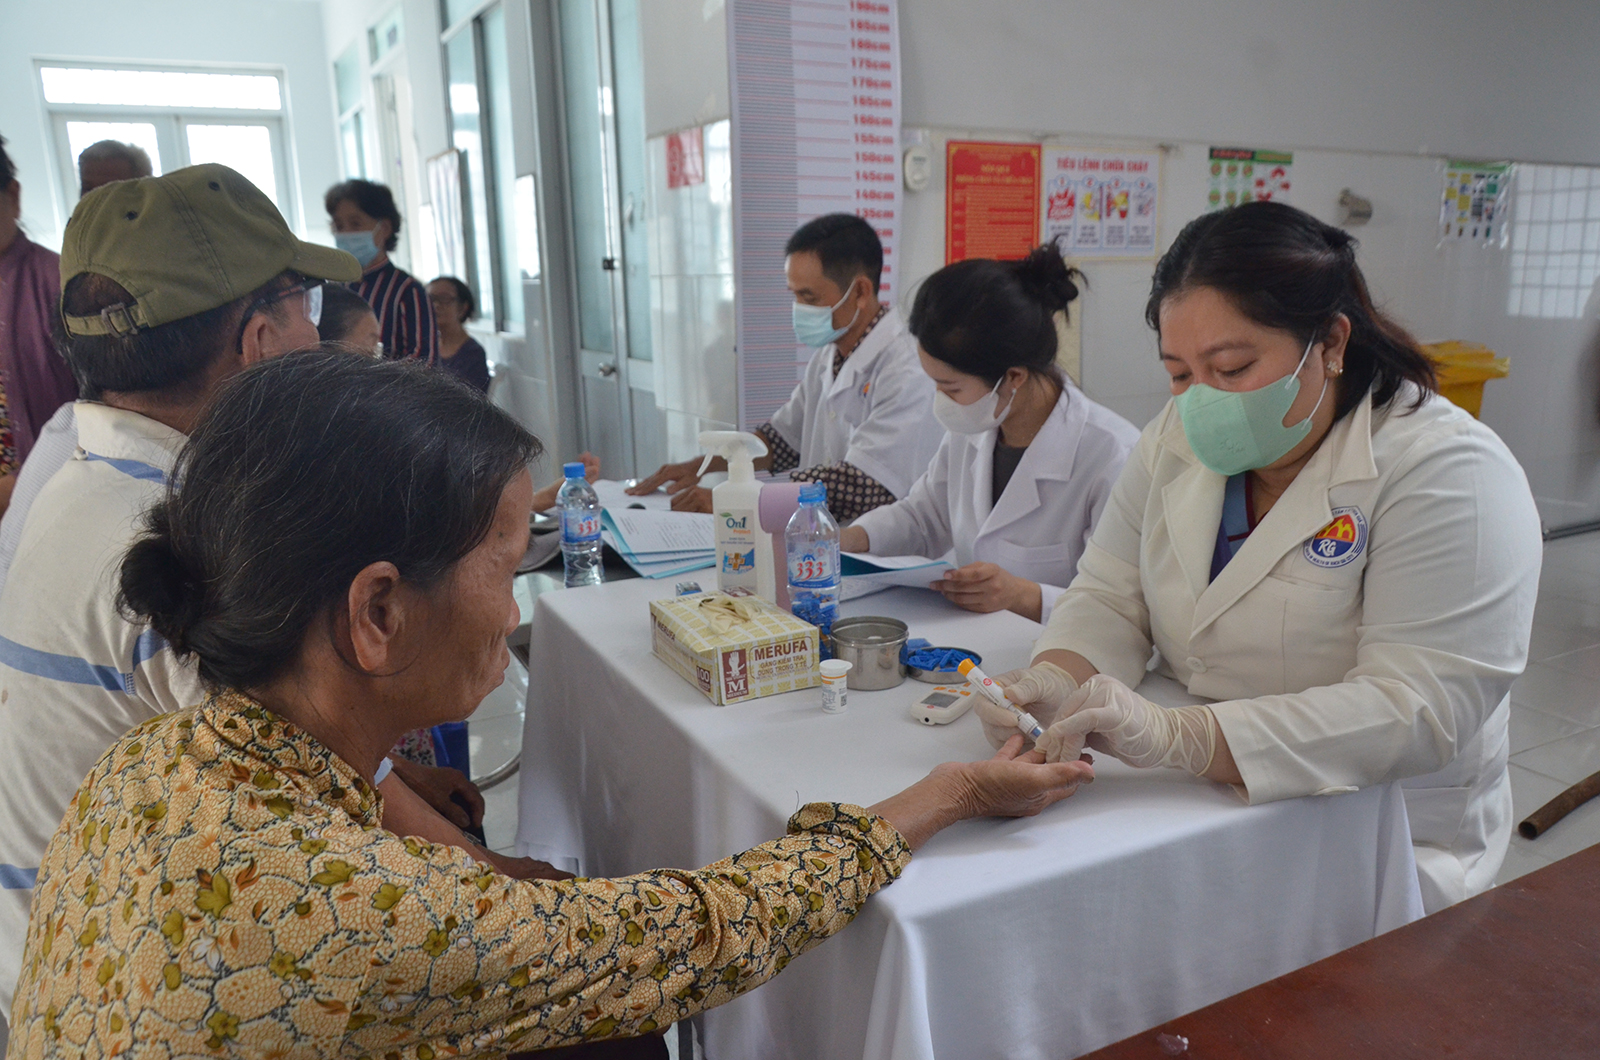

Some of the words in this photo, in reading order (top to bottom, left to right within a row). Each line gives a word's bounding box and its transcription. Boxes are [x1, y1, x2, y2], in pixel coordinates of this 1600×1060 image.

[726, 516, 747, 529] On1
[1318, 538, 1337, 557] RG
[795, 561, 823, 581] 333
[657, 620, 676, 641] MERUFA
[754, 640, 808, 661] MERUFA
[696, 666, 710, 683] 100
[727, 679, 746, 694] M
